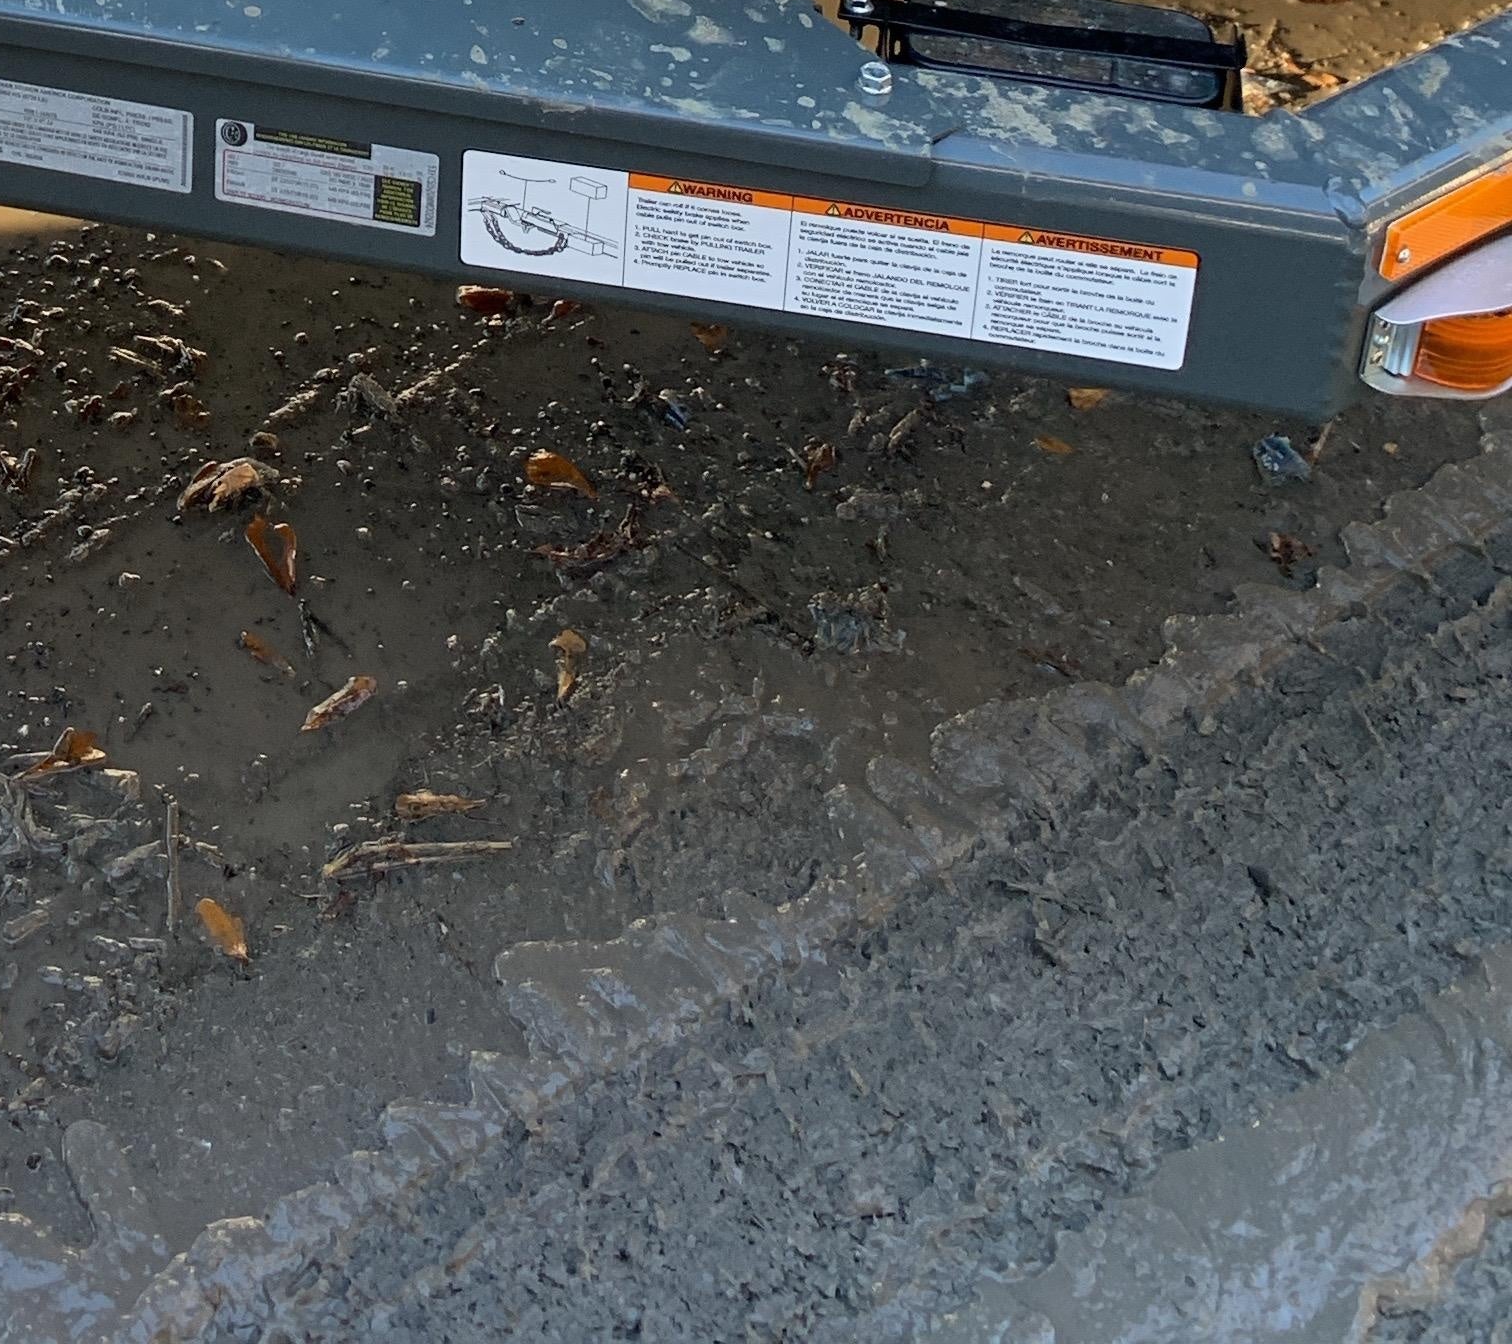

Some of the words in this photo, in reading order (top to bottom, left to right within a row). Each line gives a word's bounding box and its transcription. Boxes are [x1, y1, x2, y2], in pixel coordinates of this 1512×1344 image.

[681, 183, 753, 204] WARNING
[641, 225, 661, 233] PULL
[844, 207, 950, 231] ADVERTENCIA
[640, 245, 669, 255] ATTACH
[681, 251, 706, 260] CABLE
[642, 232, 669, 241] CHECK
[699, 240, 733, 250] PULLING
[733, 245, 765, 255] TRAILER
[1035, 234, 1164, 262] AVERTISSEMENT
[672, 263, 706, 274] REPLACE
